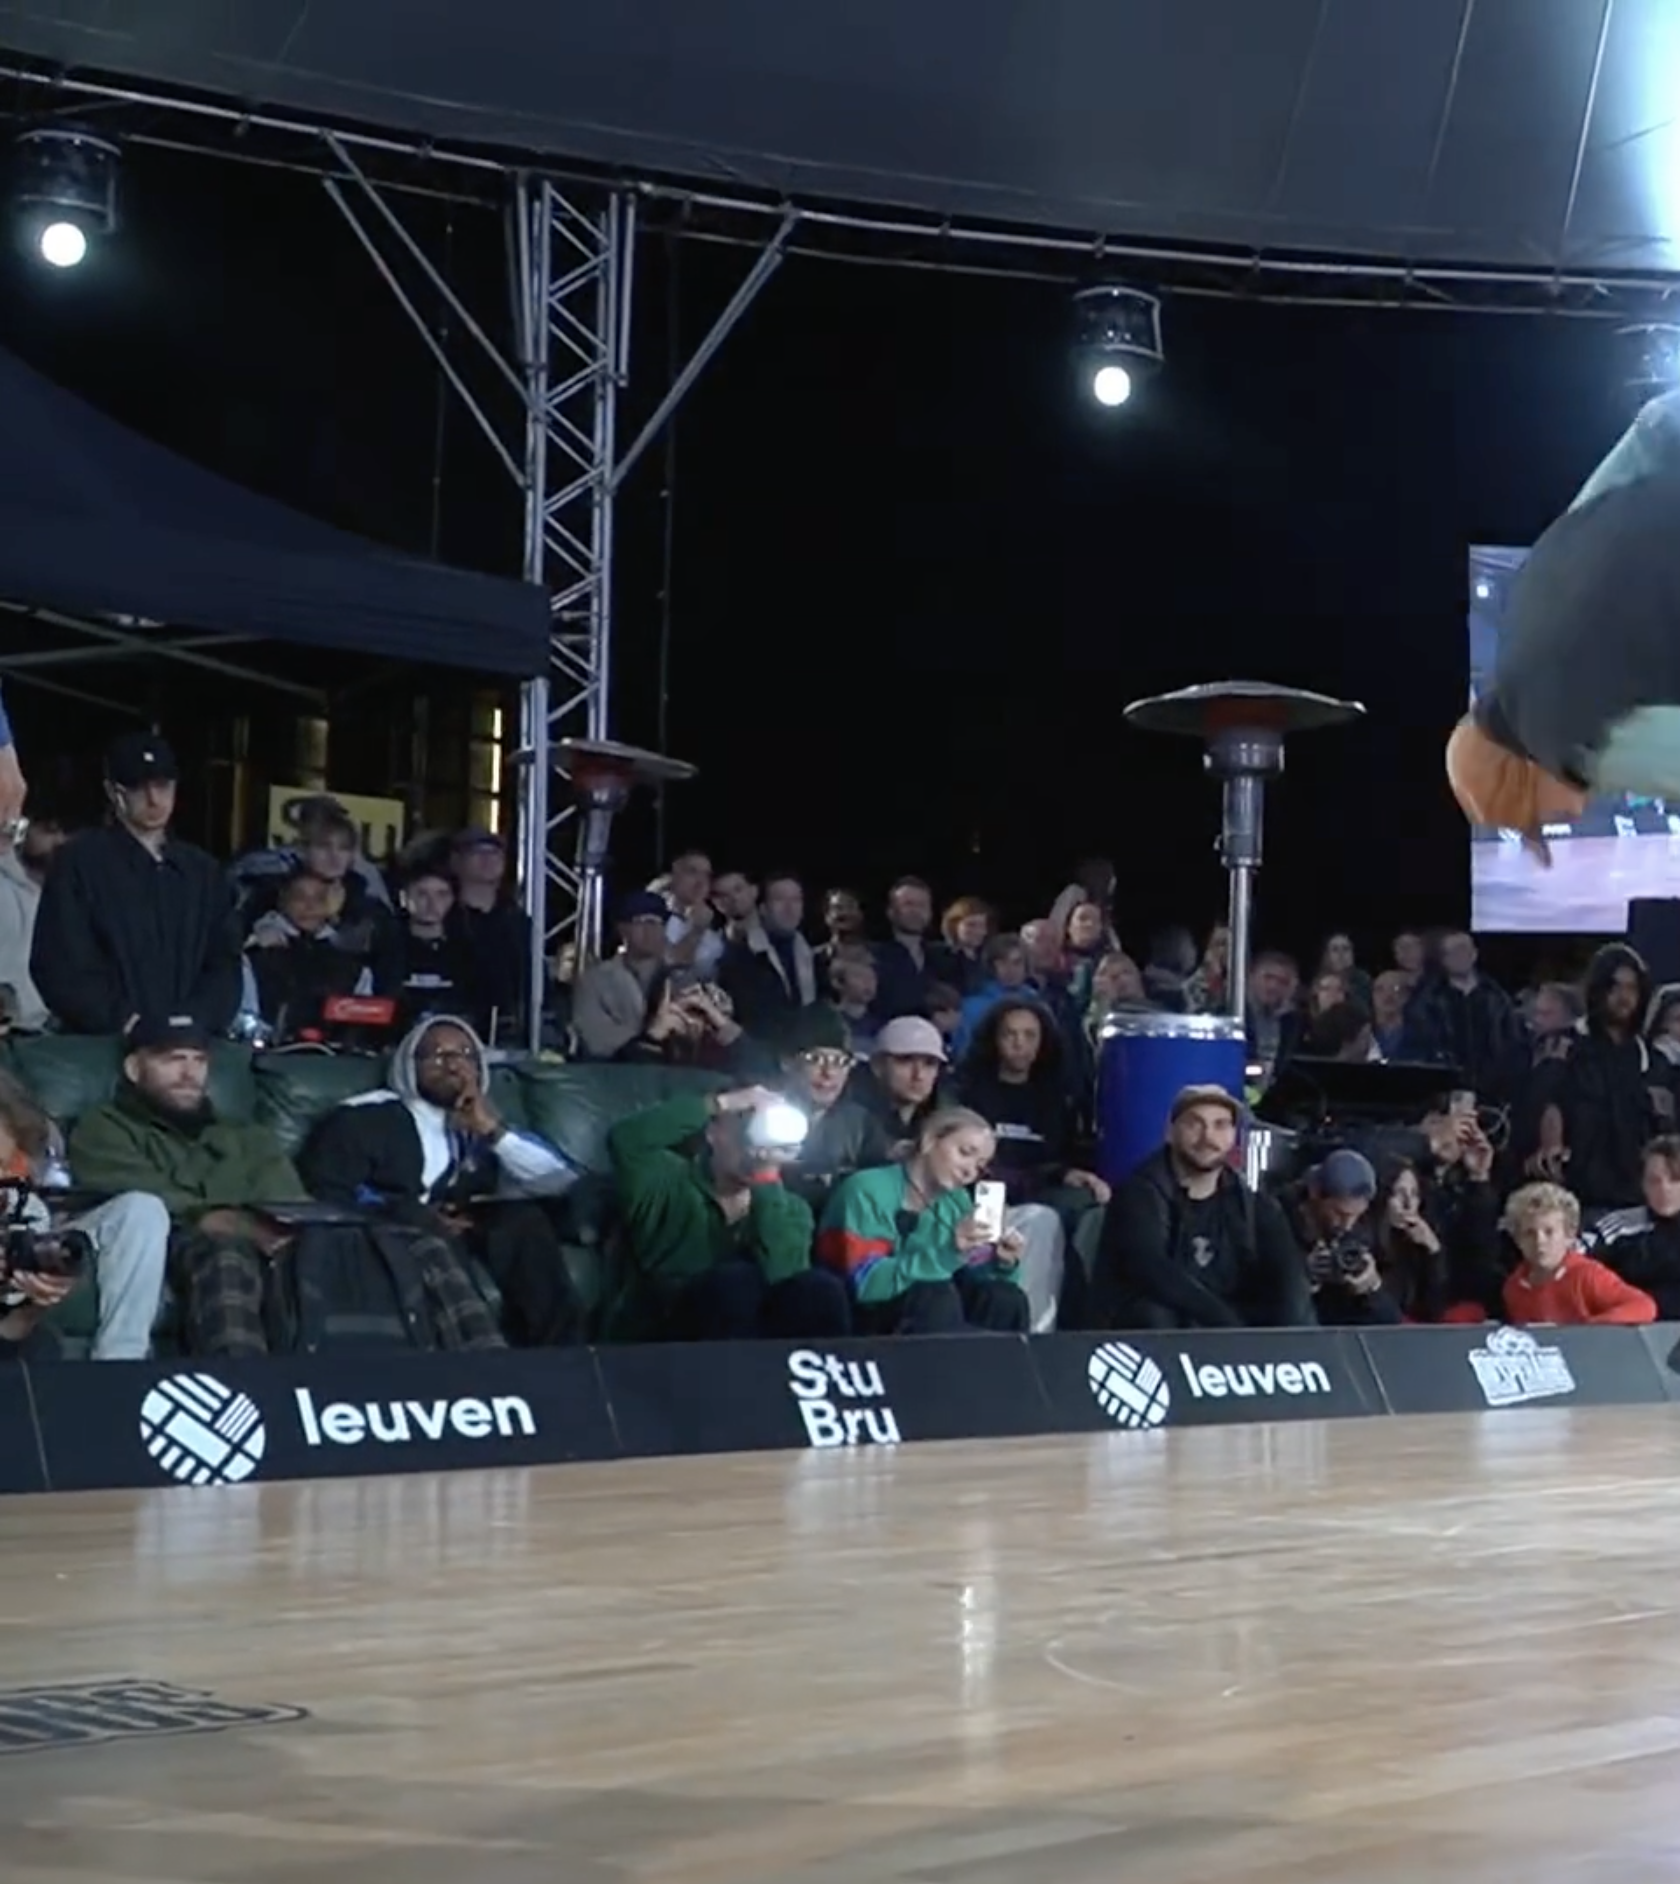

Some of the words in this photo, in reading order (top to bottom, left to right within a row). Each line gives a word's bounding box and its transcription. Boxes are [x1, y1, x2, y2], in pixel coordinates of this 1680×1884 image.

[788, 1349, 886, 1399] Stu
[1179, 1353, 1331, 1397] leuven
[295, 1388, 537, 1445] leuven
[798, 1400, 902, 1447] Bru
